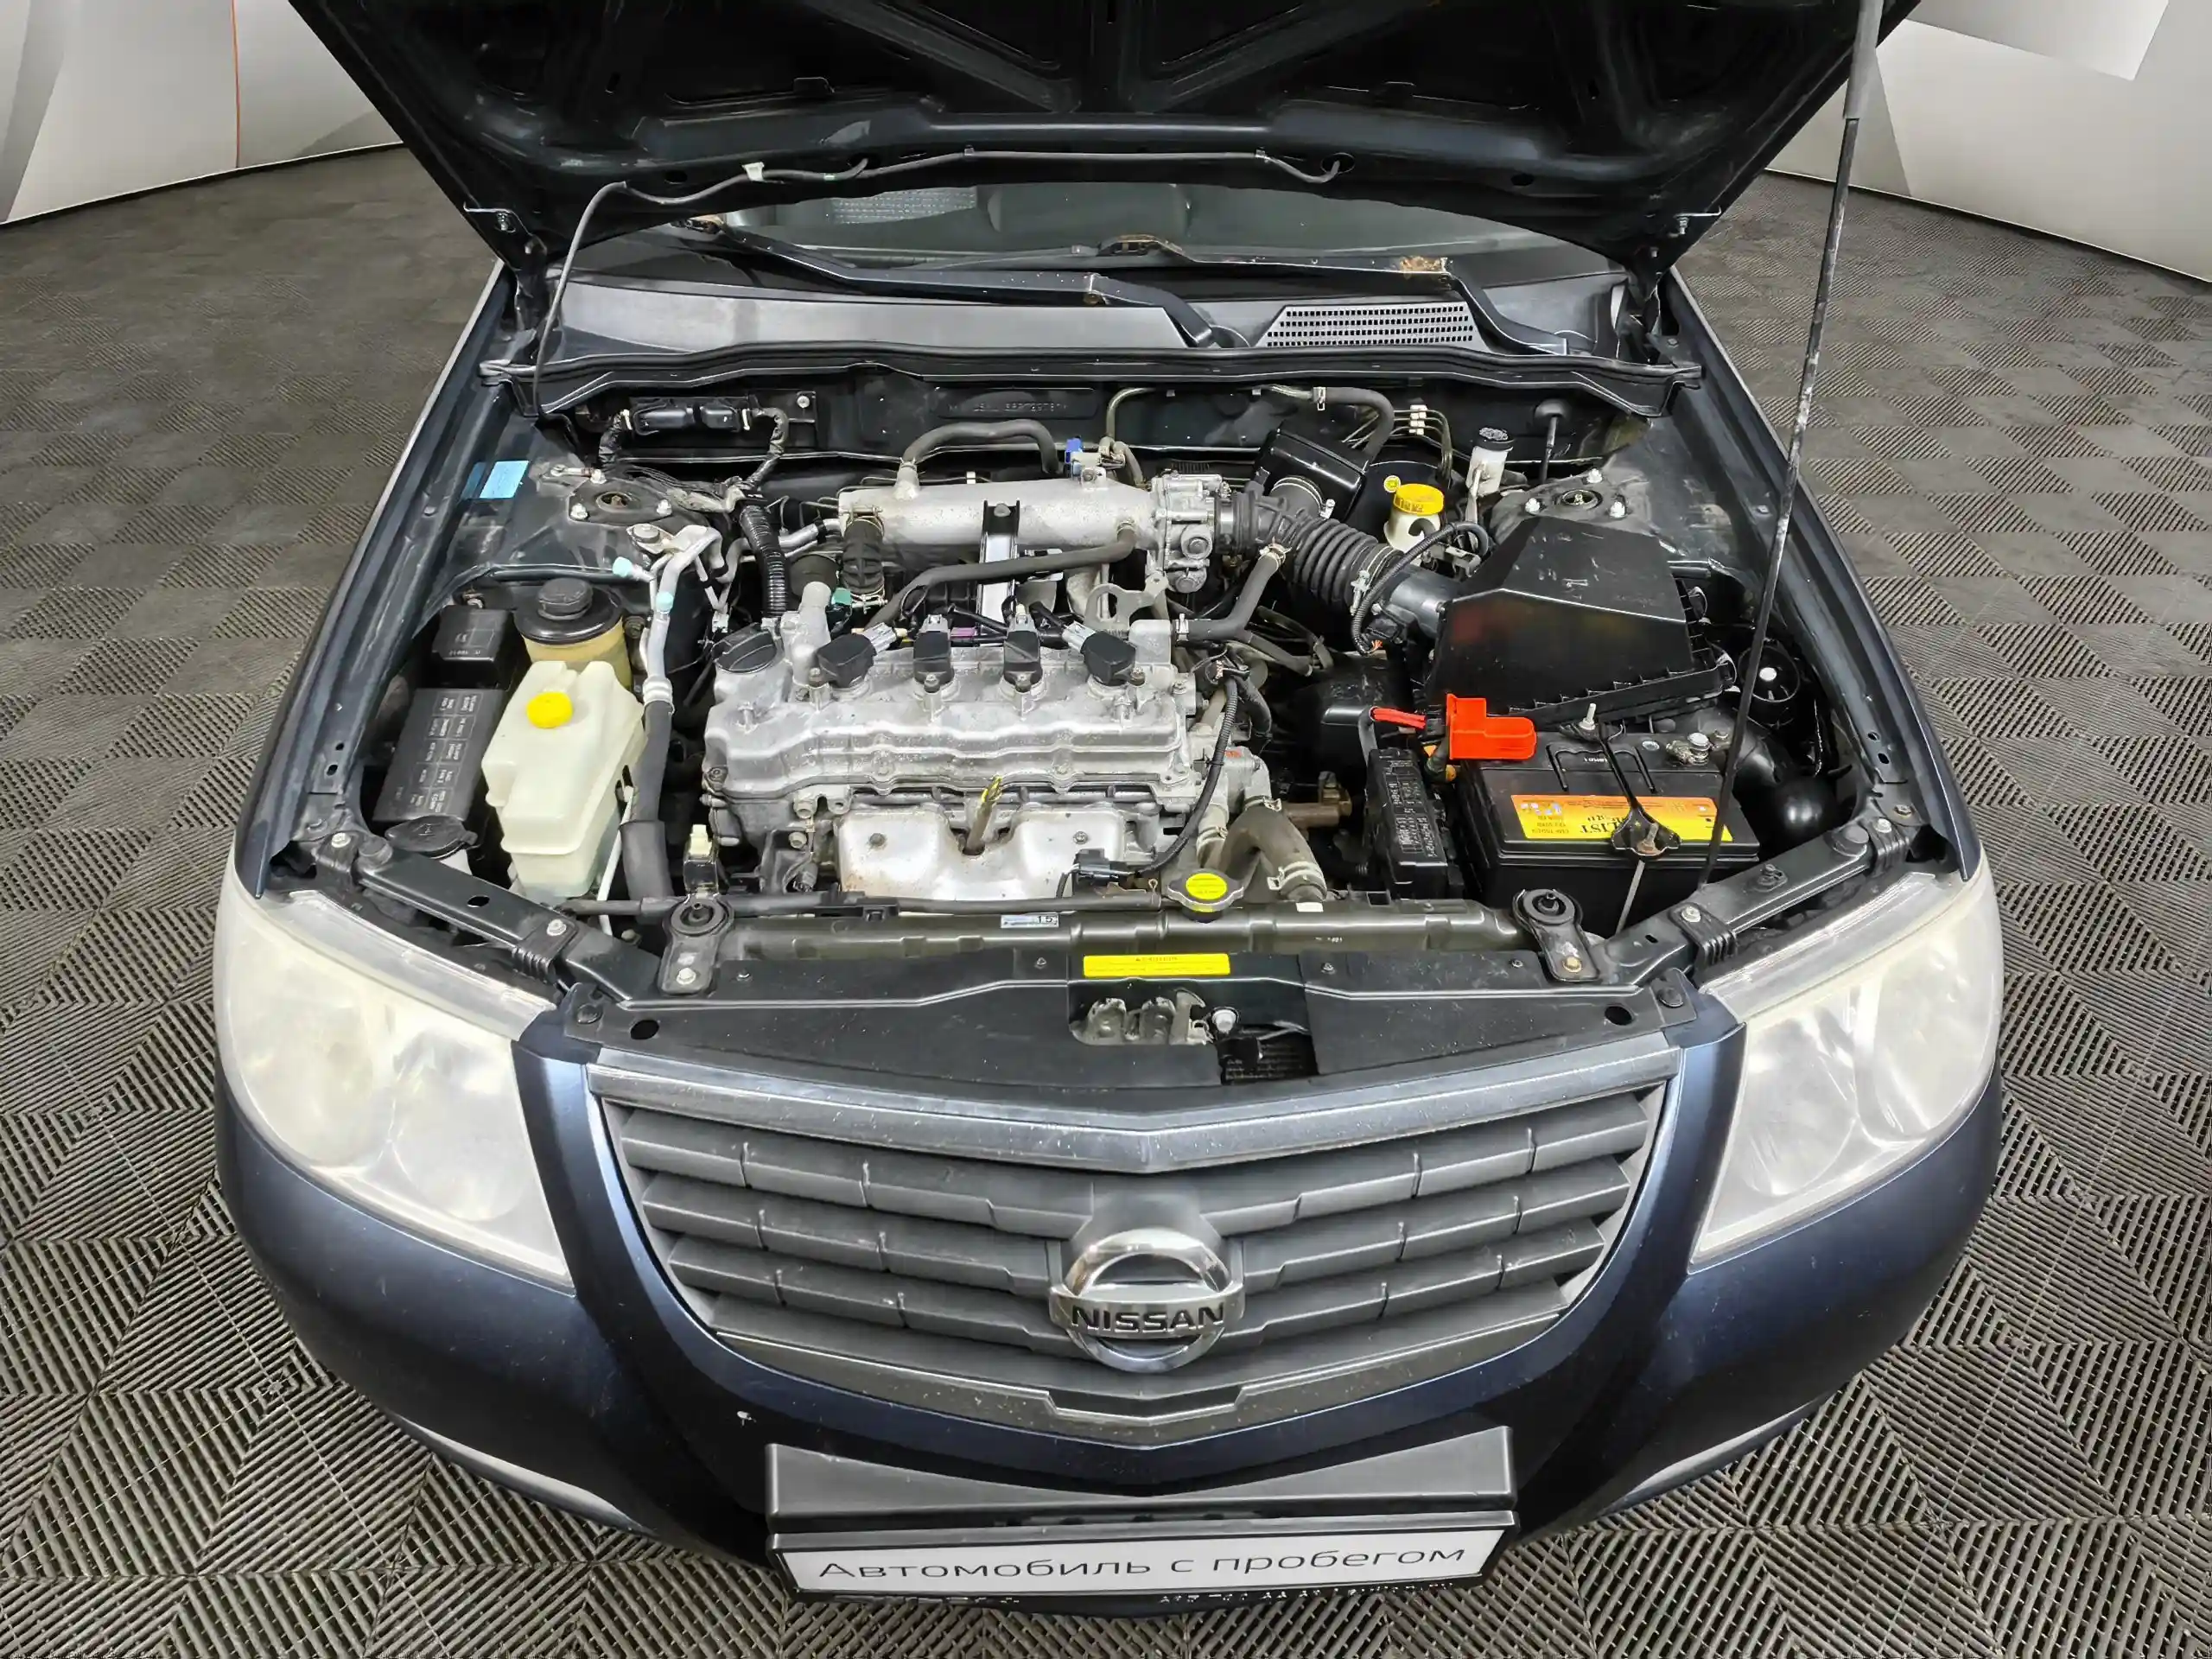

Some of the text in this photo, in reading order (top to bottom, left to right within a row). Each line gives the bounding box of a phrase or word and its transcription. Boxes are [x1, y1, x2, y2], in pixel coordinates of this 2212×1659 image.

[1071, 1303, 1224, 1332] NISSAN
[819, 1548, 1465, 1578] Автомобиль с пробегом
